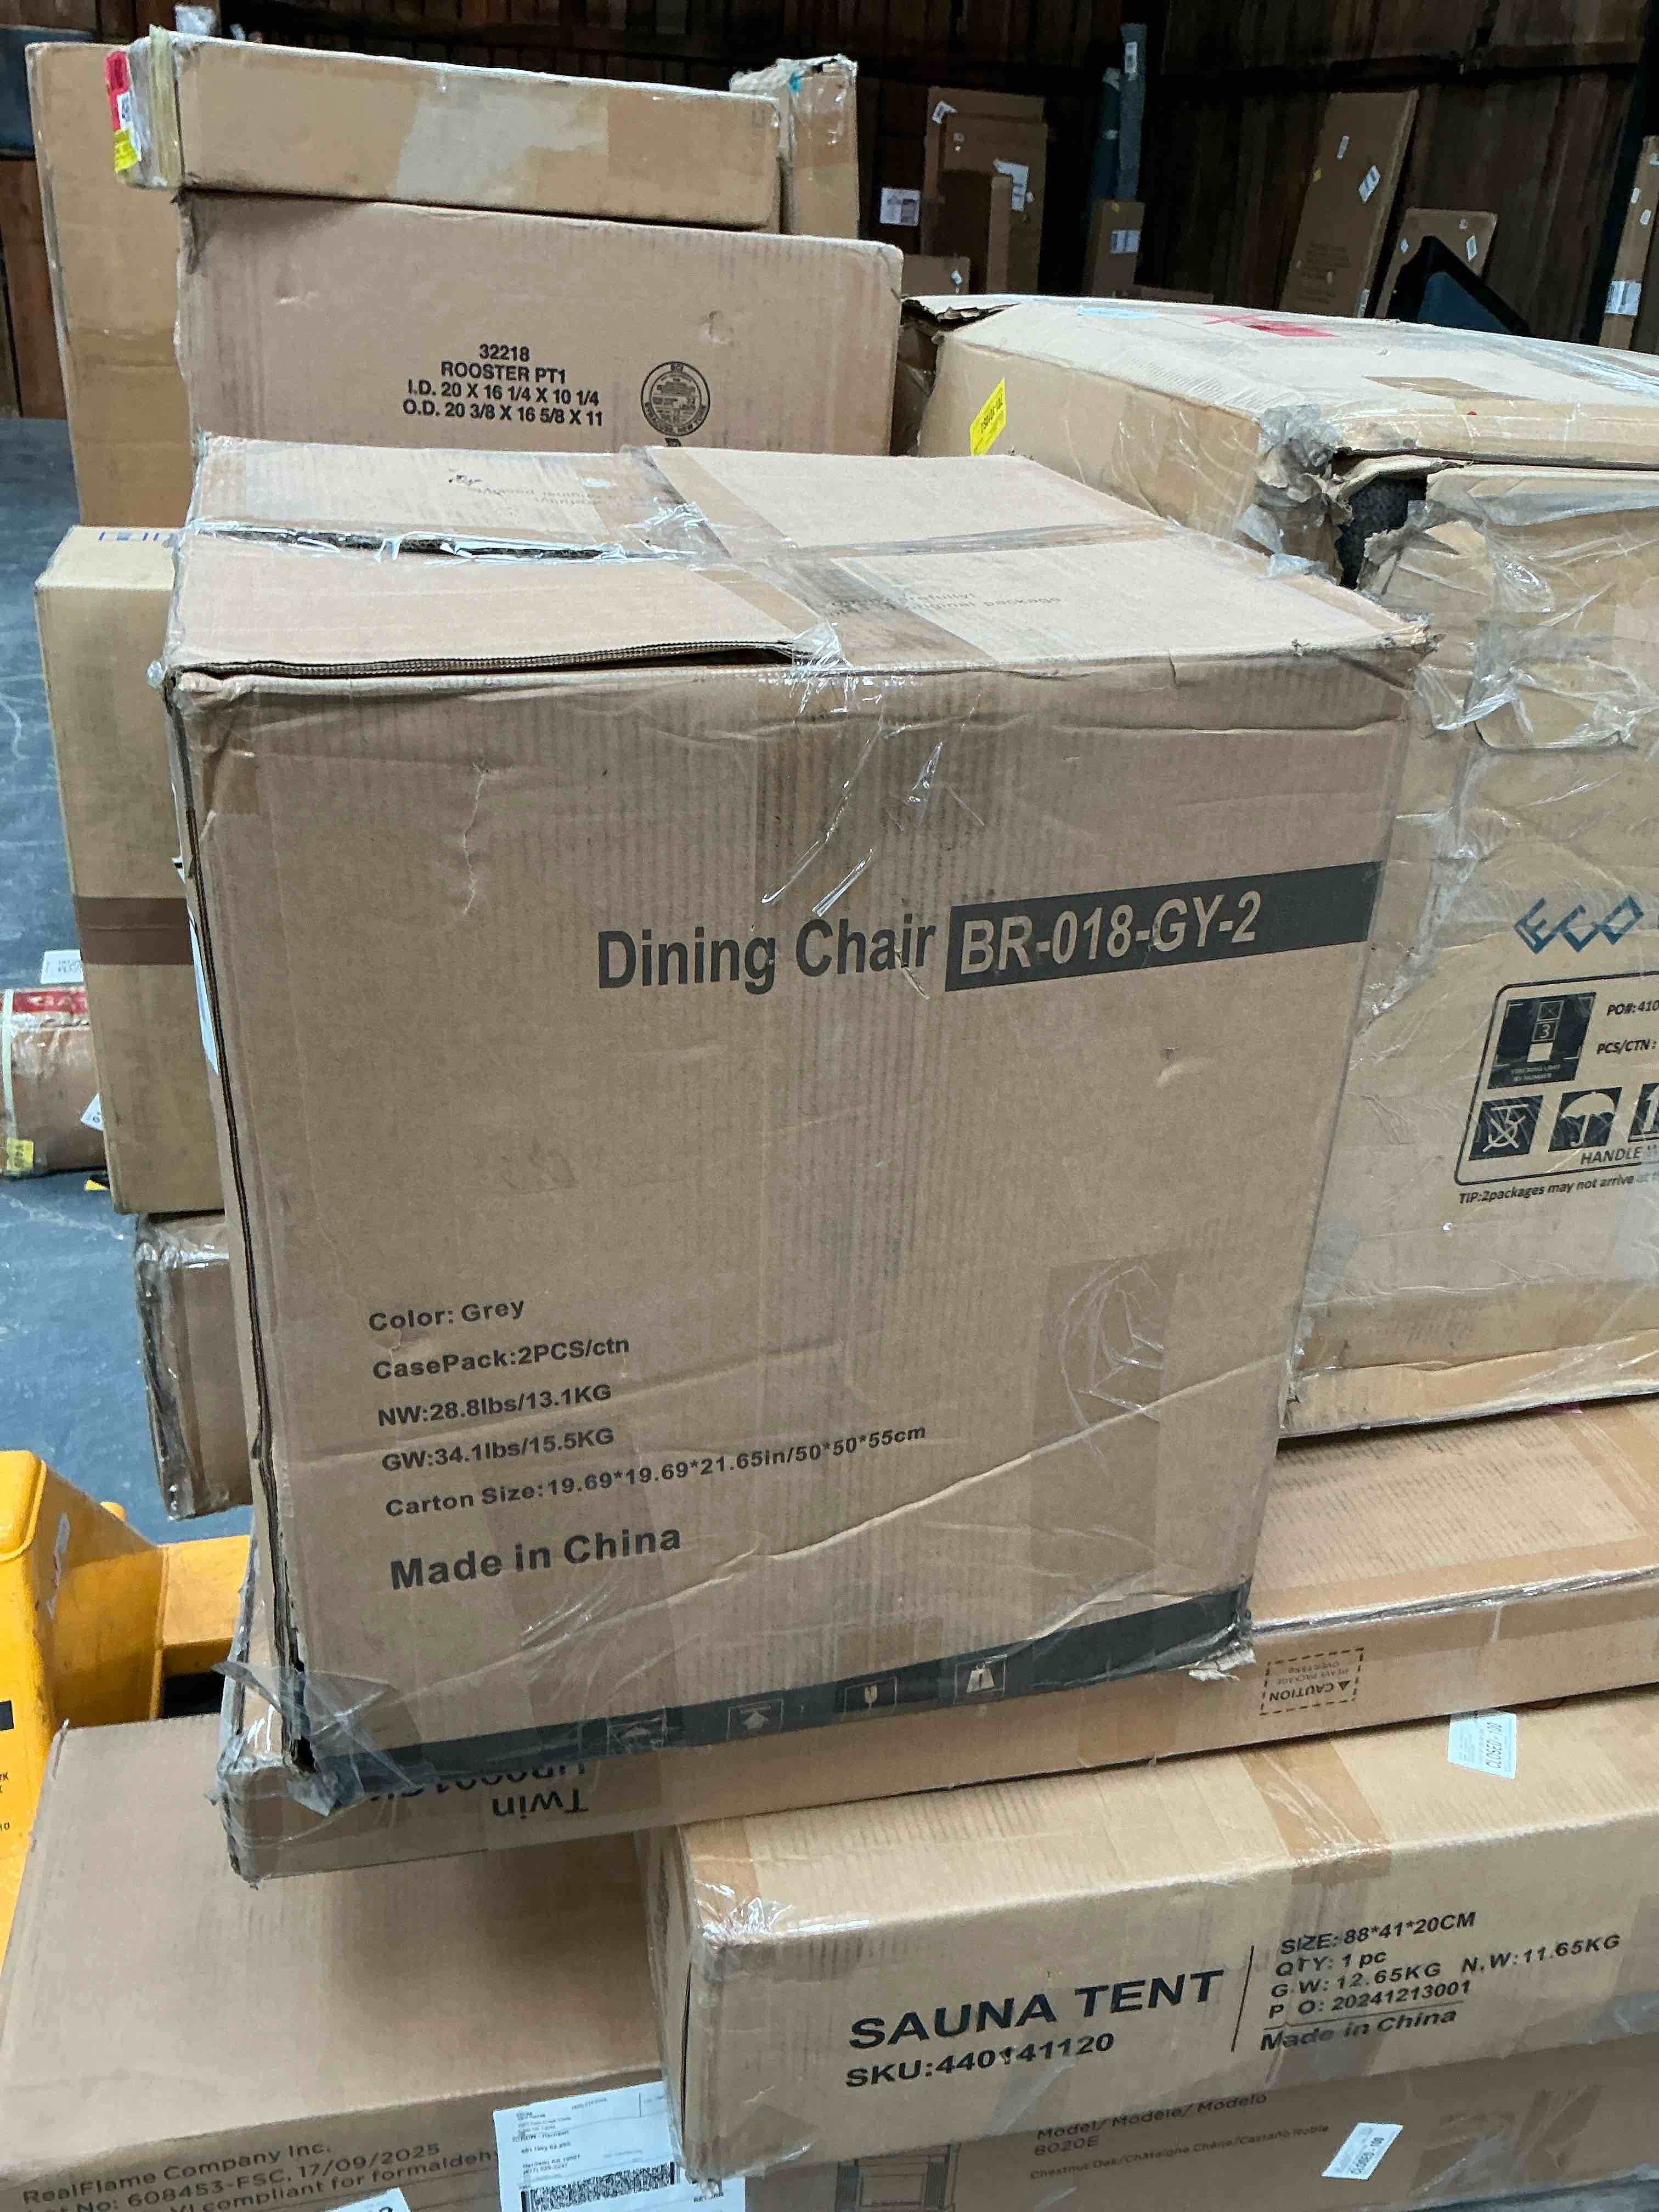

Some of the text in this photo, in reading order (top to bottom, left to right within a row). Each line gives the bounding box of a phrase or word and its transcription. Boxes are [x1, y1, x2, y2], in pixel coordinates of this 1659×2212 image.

[479, 343, 531, 362] 32218
[441, 361, 566, 384] ROOSTER PT1
[408, 379, 599, 407] I.D. 20 X 16 1/4 X 10 1/4
[403, 399, 602, 426] O.D. 20 3/8 X 16 5/8 X 11
[598, 890, 1261, 995] Dining Chair BR-018-GY-2
[1539, 1023, 1550, 1039] 3
[1580, 1146, 1641, 1165] HANDLE
[1547, 1182, 1573, 1194] may
[1576, 1178, 1596, 1190] not
[1599, 1174, 1634, 1186] arrive
[369, 1300, 524, 1331] Color: Grey
[373, 1338, 630, 1379] CasePack:2PCS/ctn
[377, 1383, 612, 1426] NW:28.8lbs/13.1KG
[382, 1427, 614, 1471] GW:34.1lbs/15.5KG
[386, 1493, 475, 1517] Carton
[391, 1528, 681, 1590] Made in China
[1269, 1683, 1334, 1701] CAUTION
[493, 1787, 589, 1820] Twin
[1276, 1956, 1334, 1977] QTY:
[1359, 1951, 1386, 1968] pc
[849, 1970, 1224, 2050] SAUNA TENT
[1260, 2010, 1457, 2051] Made in China
[845, 2033, 1115, 2087] SKU:440141120
[23, 2142, 330, 2204] RealFlame Company Inc.
[202, 2181, 325, 2212] compliant
[331, 2176, 364, 2190] for
